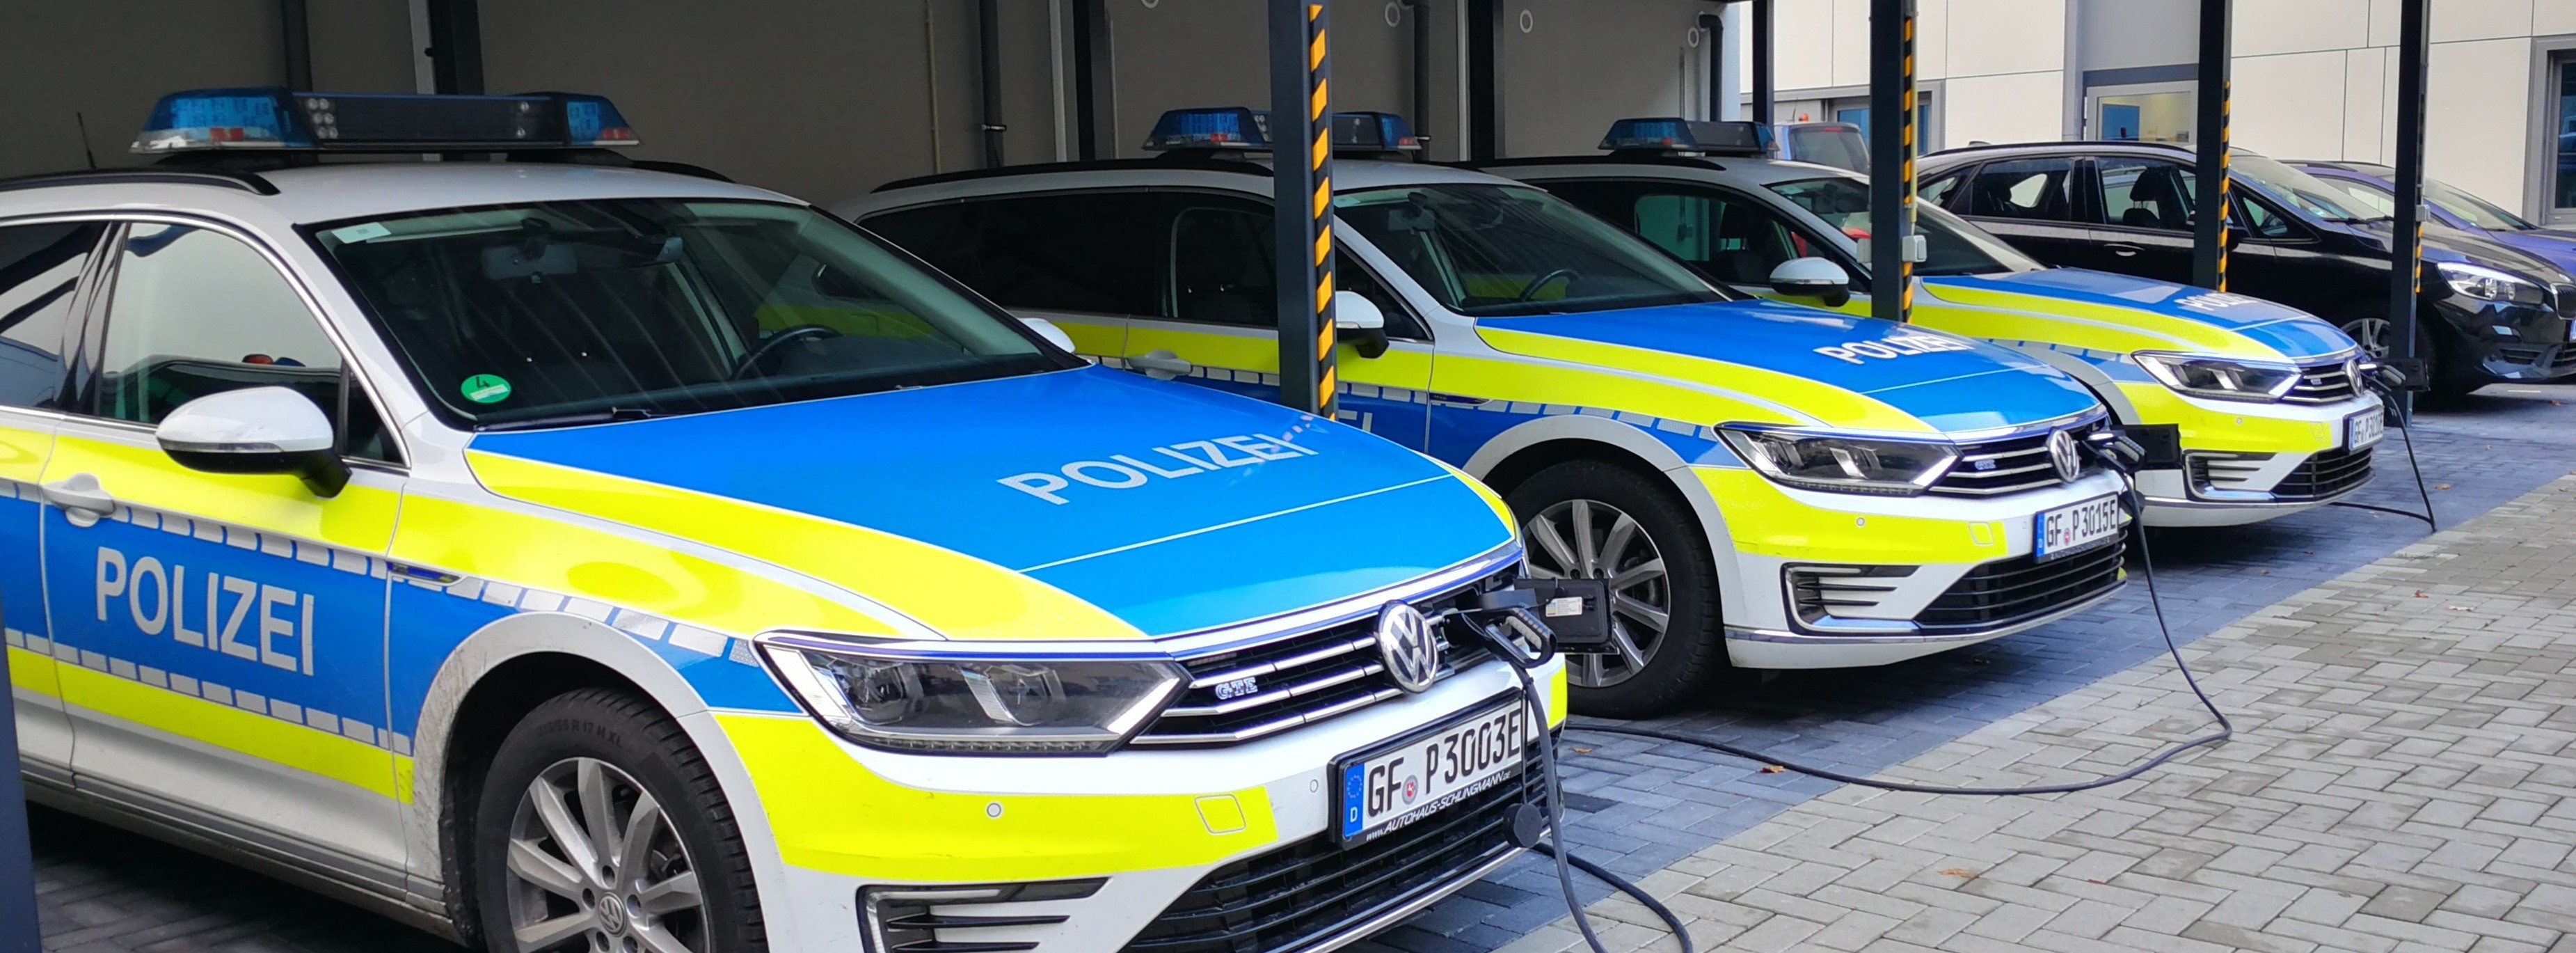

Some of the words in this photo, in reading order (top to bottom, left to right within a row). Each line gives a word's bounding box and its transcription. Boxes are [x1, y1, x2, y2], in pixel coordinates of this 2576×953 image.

[1813, 336, 1975, 364] POLIZEI
[476, 376, 490, 388] 4
[996, 433, 1319, 505] POLIZEI
[2046, 514, 2062, 547] GF
[96, 546, 314, 677] POLIZEI
[1216, 677, 1258, 700] GTE
[1367, 757, 1404, 818] GF
[1350, 806, 1358, 823] D
